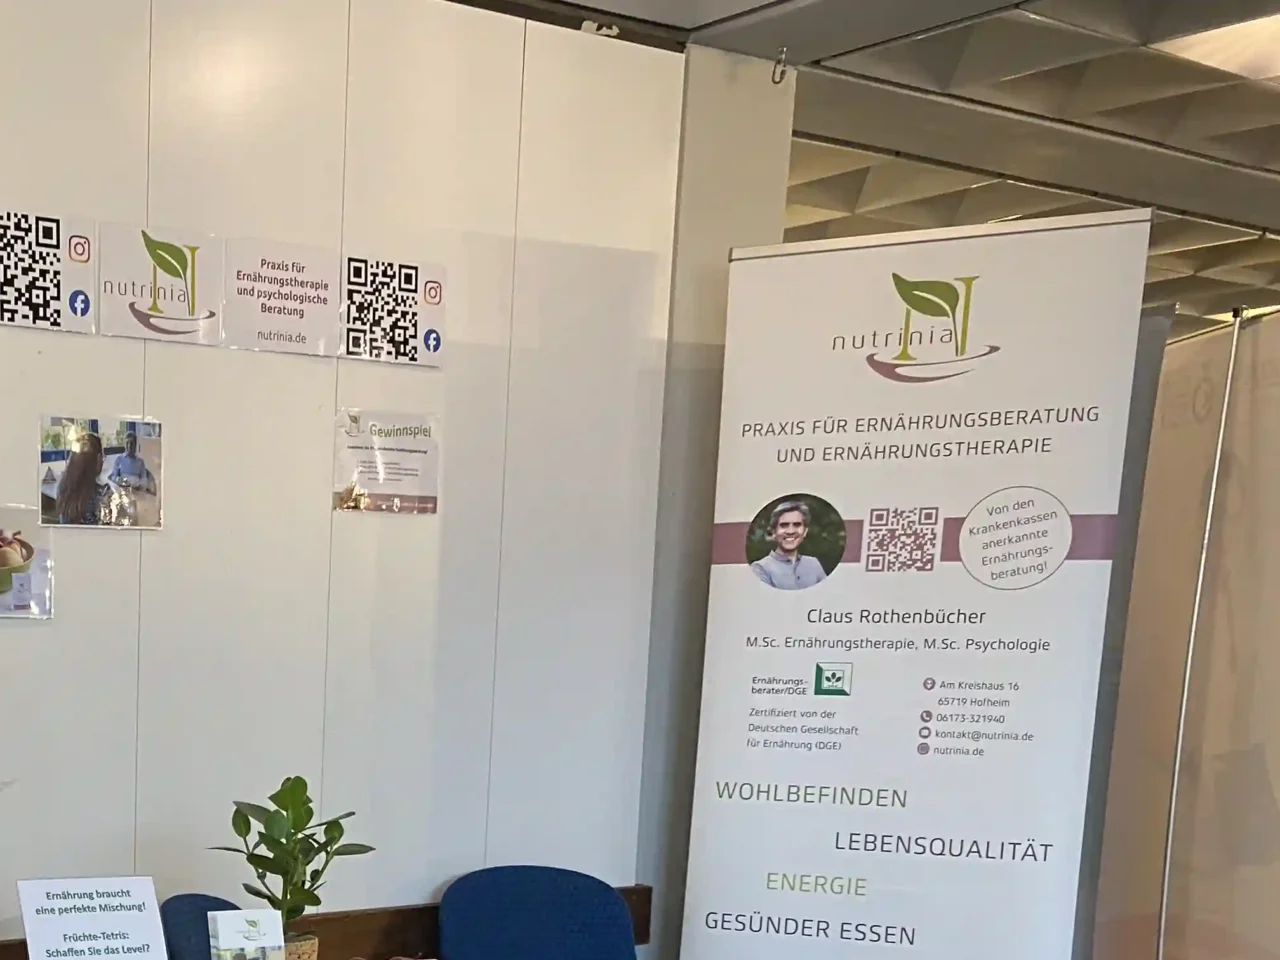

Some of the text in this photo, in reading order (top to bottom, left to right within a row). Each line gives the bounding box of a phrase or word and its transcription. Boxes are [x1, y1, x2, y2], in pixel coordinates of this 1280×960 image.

[260, 258, 306, 274] Praxis für
[236, 270, 329, 292] Ernährungstherapie
[104, 279, 186, 304] nutrinia
[237, 285, 328, 306] und psychologische
[261, 303, 304, 319] Beratung
[257, 330, 307, 345] nutrinia.de
[832, 324, 953, 352] nutrinia
[741, 405, 1100, 438] PRAXIS FÜR ERNÄHRUNGSBERATUNG
[370, 424, 432, 439] Gewinnspiel
[776, 437, 1053, 464] UND ERNÄHRUNGSTHERAPIE
[986, 499, 1035, 516] Von den
[969, 511, 1058, 536] Krankenkassen
[982, 529, 1049, 550] anerkannte
[981, 545, 1054, 566] Ernährungs-
[990, 561, 1049, 580] beratung!
[806, 608, 987, 625] Claus Rothenbücher
[745, 636, 1051, 654] M.Sc. Ernährungstherapie, M.Sc. Psychologie
[752, 676, 809, 687] Ernährungs-
[939, 680, 1020, 692] Am Kreishaus 16
[751, 686, 808, 696] berater/DGE
[937, 697, 1010, 707] 65719 Hofheim
[749, 708, 837, 719] Zertifiziert von der
[748, 723, 859, 736] Deutschen Gesellschaft
[935, 729, 1035, 742] kontakt@nutrinia.de
[746, 738, 842, 752] für Ernährung (DGE)
[933, 746, 985, 757] nutrinia.de
[715, 780, 908, 809] WOHLBEFINDEN
[834, 830, 1054, 863] LEBENSQUALITÄT
[766, 871, 868, 897] ENERGIE
[45, 888, 132, 902] Ernährung braucht
[35, 901, 147, 917] eine perfekte Mischung!
[704, 910, 917, 946] GESÜNDER ESSEN
[62, 930, 130, 944] Früchte-Tetris:
[45, 943, 150, 958] Schaffen Sie das Level?
